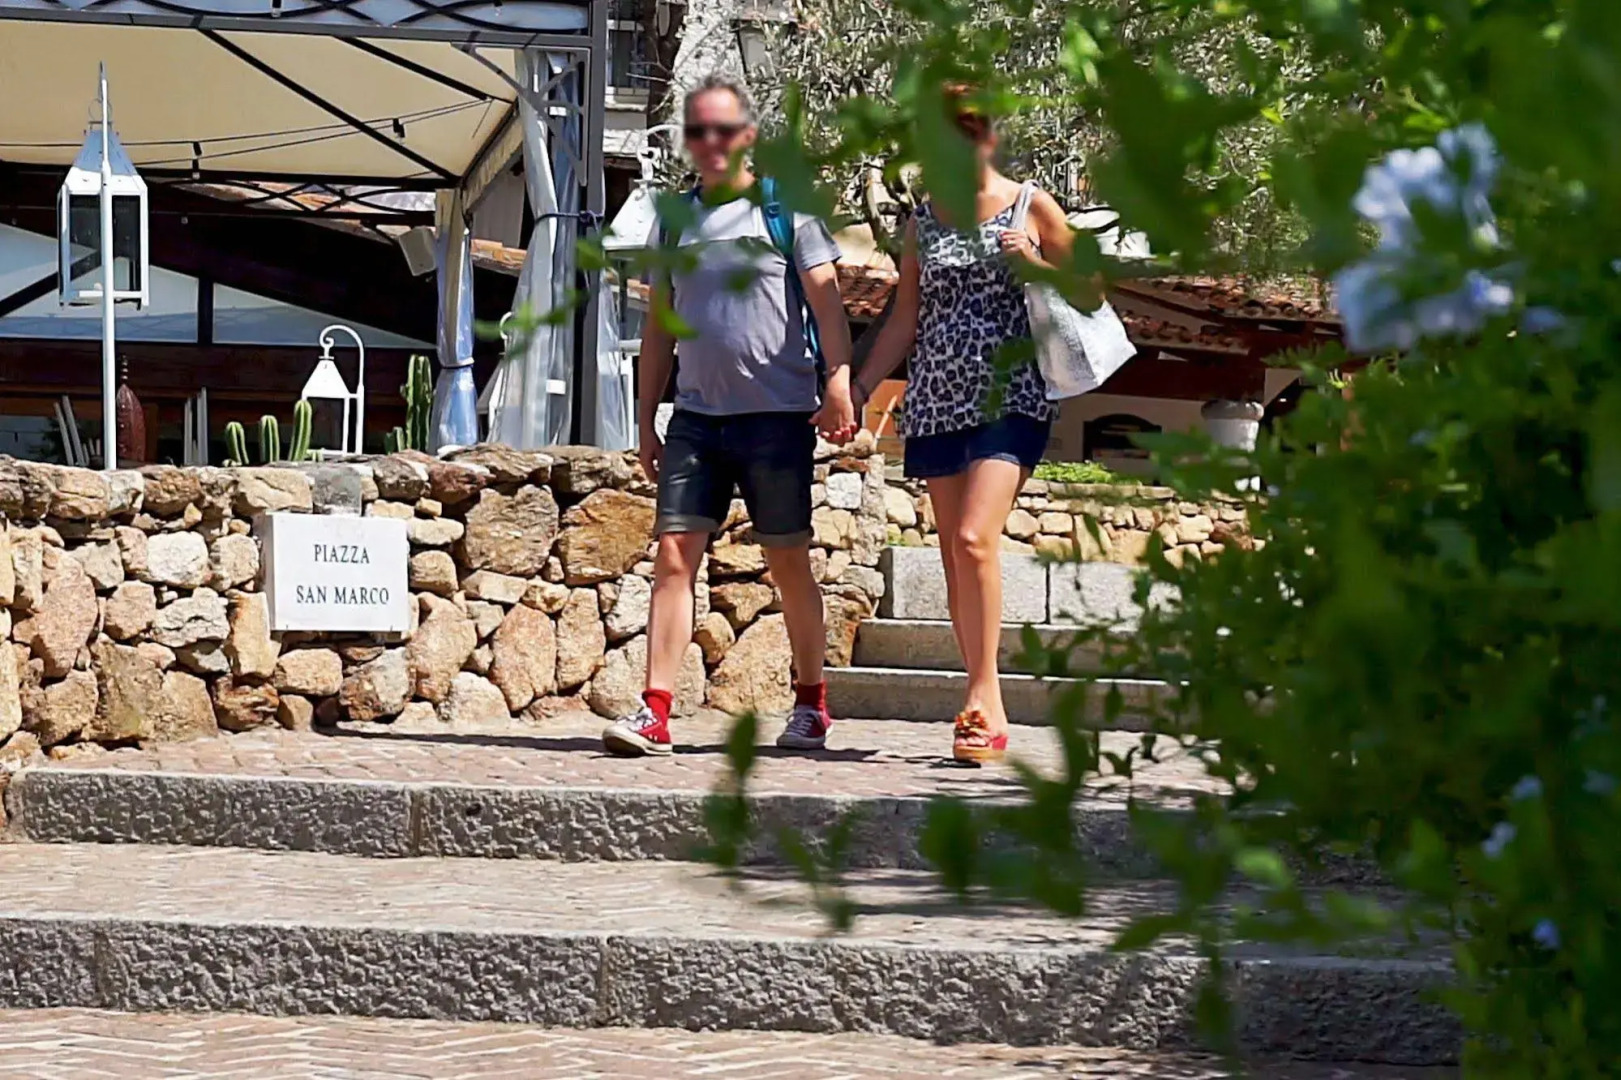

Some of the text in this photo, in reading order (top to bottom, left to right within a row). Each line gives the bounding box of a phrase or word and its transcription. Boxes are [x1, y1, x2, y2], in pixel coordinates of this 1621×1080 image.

[313, 543, 370, 564] PIAZZA
[296, 584, 389, 605] SAN MARCO
